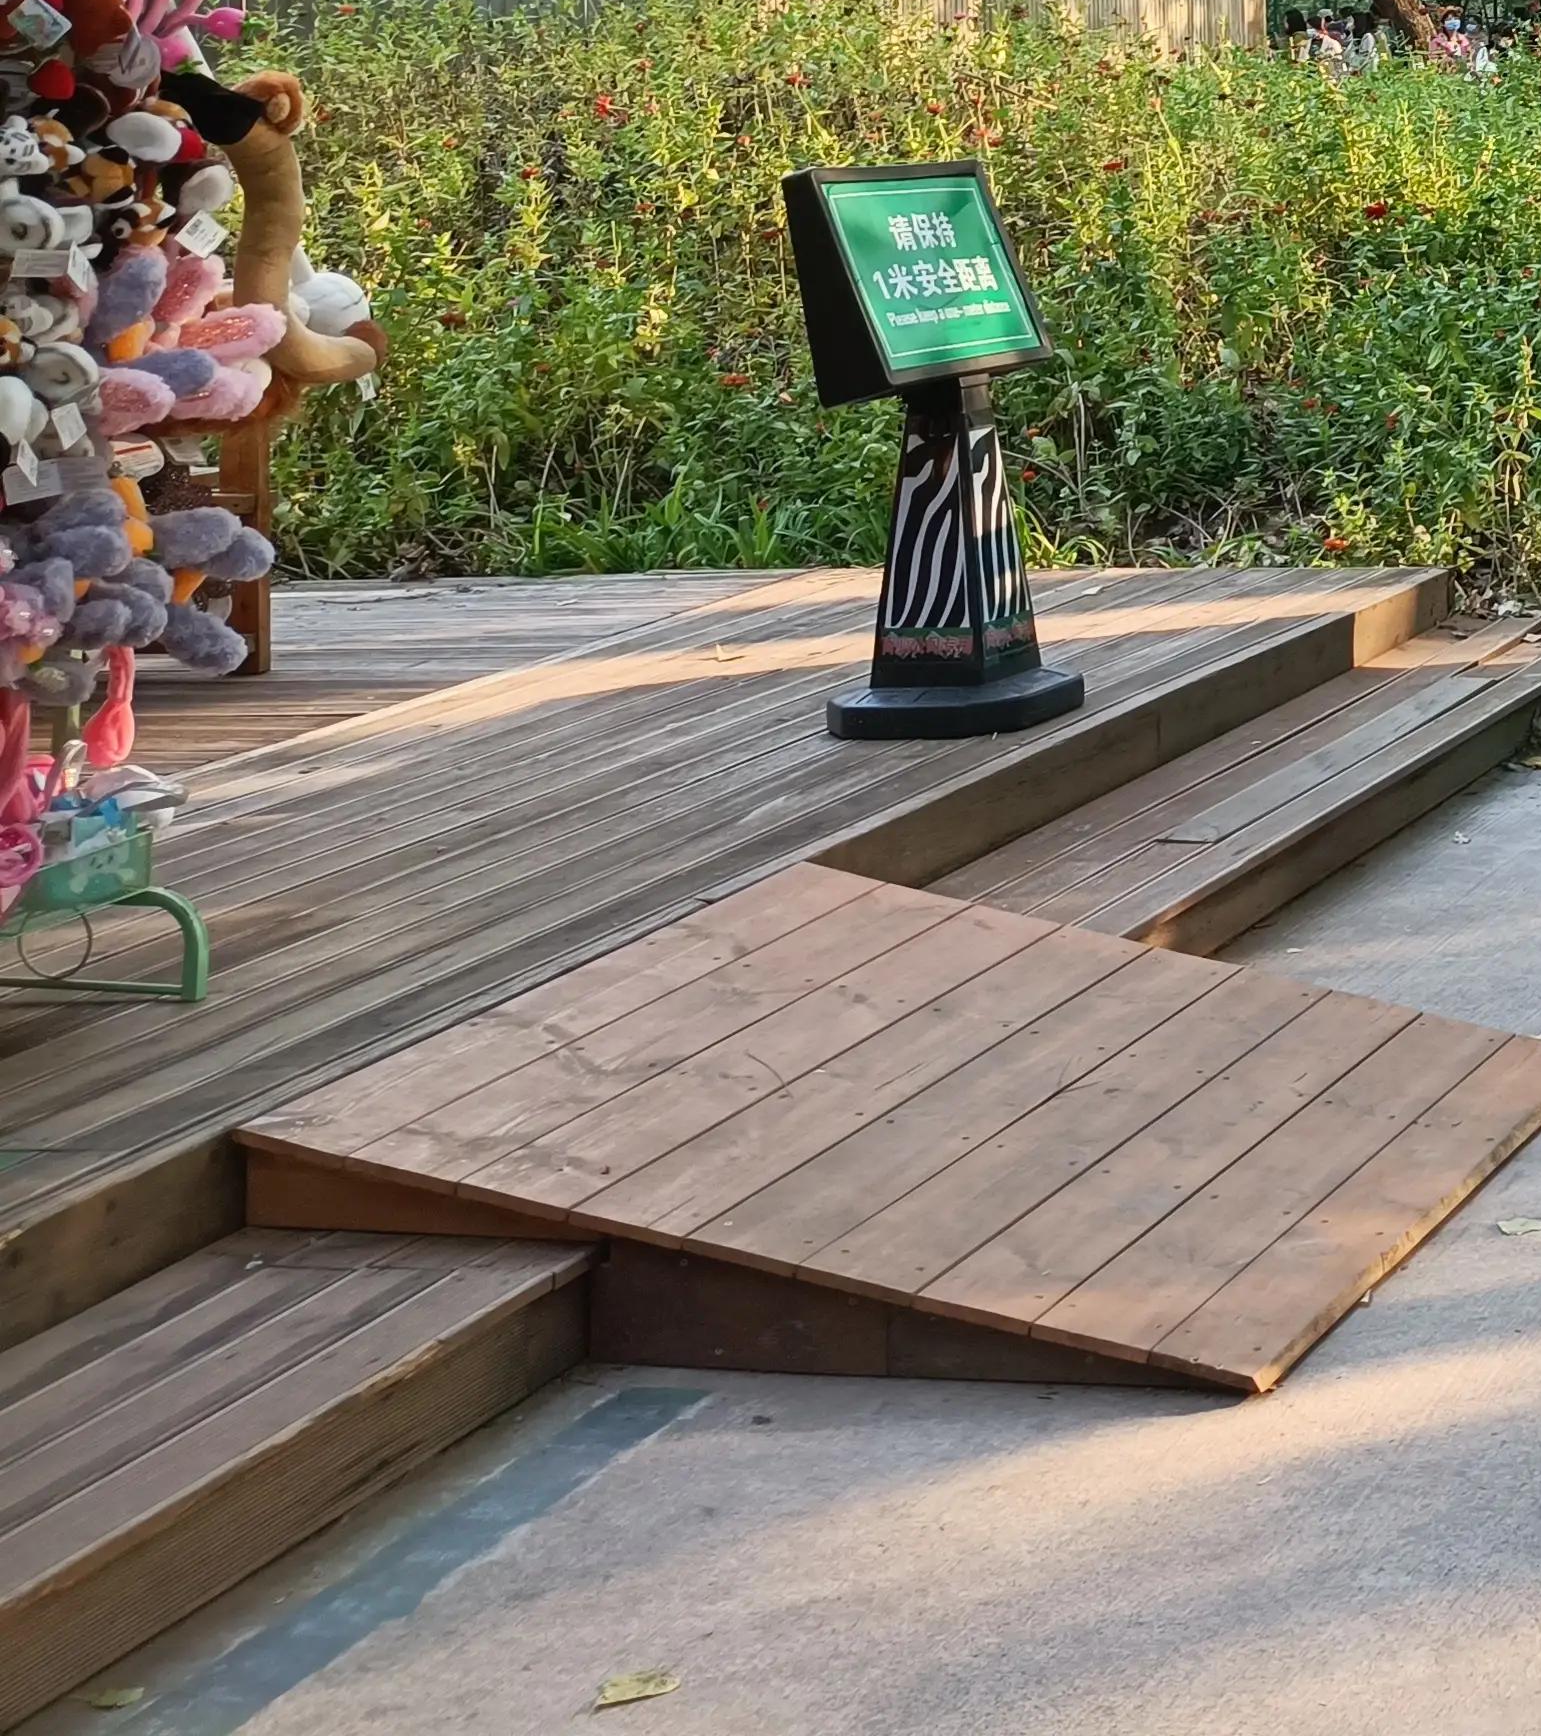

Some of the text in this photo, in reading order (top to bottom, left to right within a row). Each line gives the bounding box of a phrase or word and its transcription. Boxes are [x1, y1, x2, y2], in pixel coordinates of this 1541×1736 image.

[887, 211, 957, 252] 请保持
[872, 255, 999, 301] 1米安全距离
